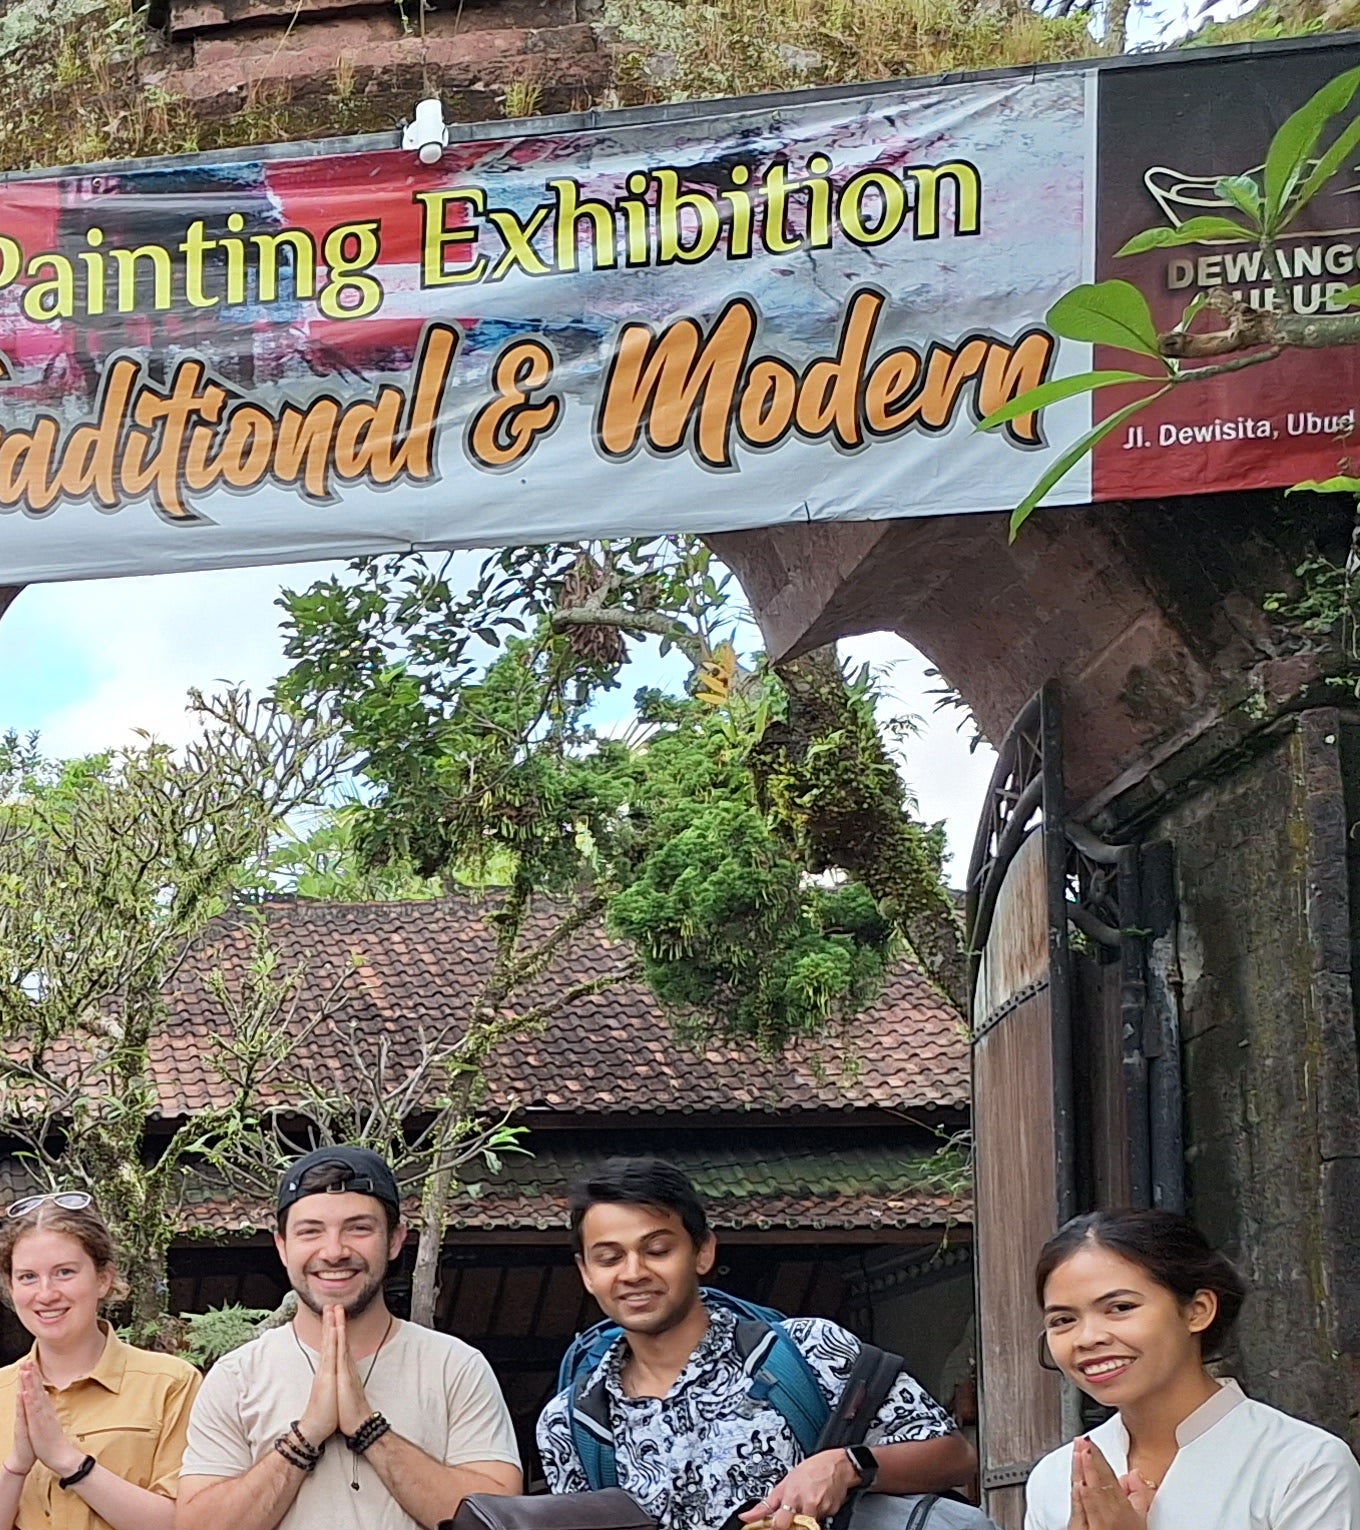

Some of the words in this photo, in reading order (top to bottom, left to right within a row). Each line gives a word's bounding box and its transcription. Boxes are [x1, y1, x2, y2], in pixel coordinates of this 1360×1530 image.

[414, 152, 982, 290] Exhibition
[1167, 243, 1360, 291] DEWANG
[468, 337, 562, 468] &
[598, 285, 1062, 471] Modern
[1123, 426, 1152, 449] Jl.
[1159, 415, 1279, 446] Dewisita,
[1287, 409, 1355, 437] Ubud
